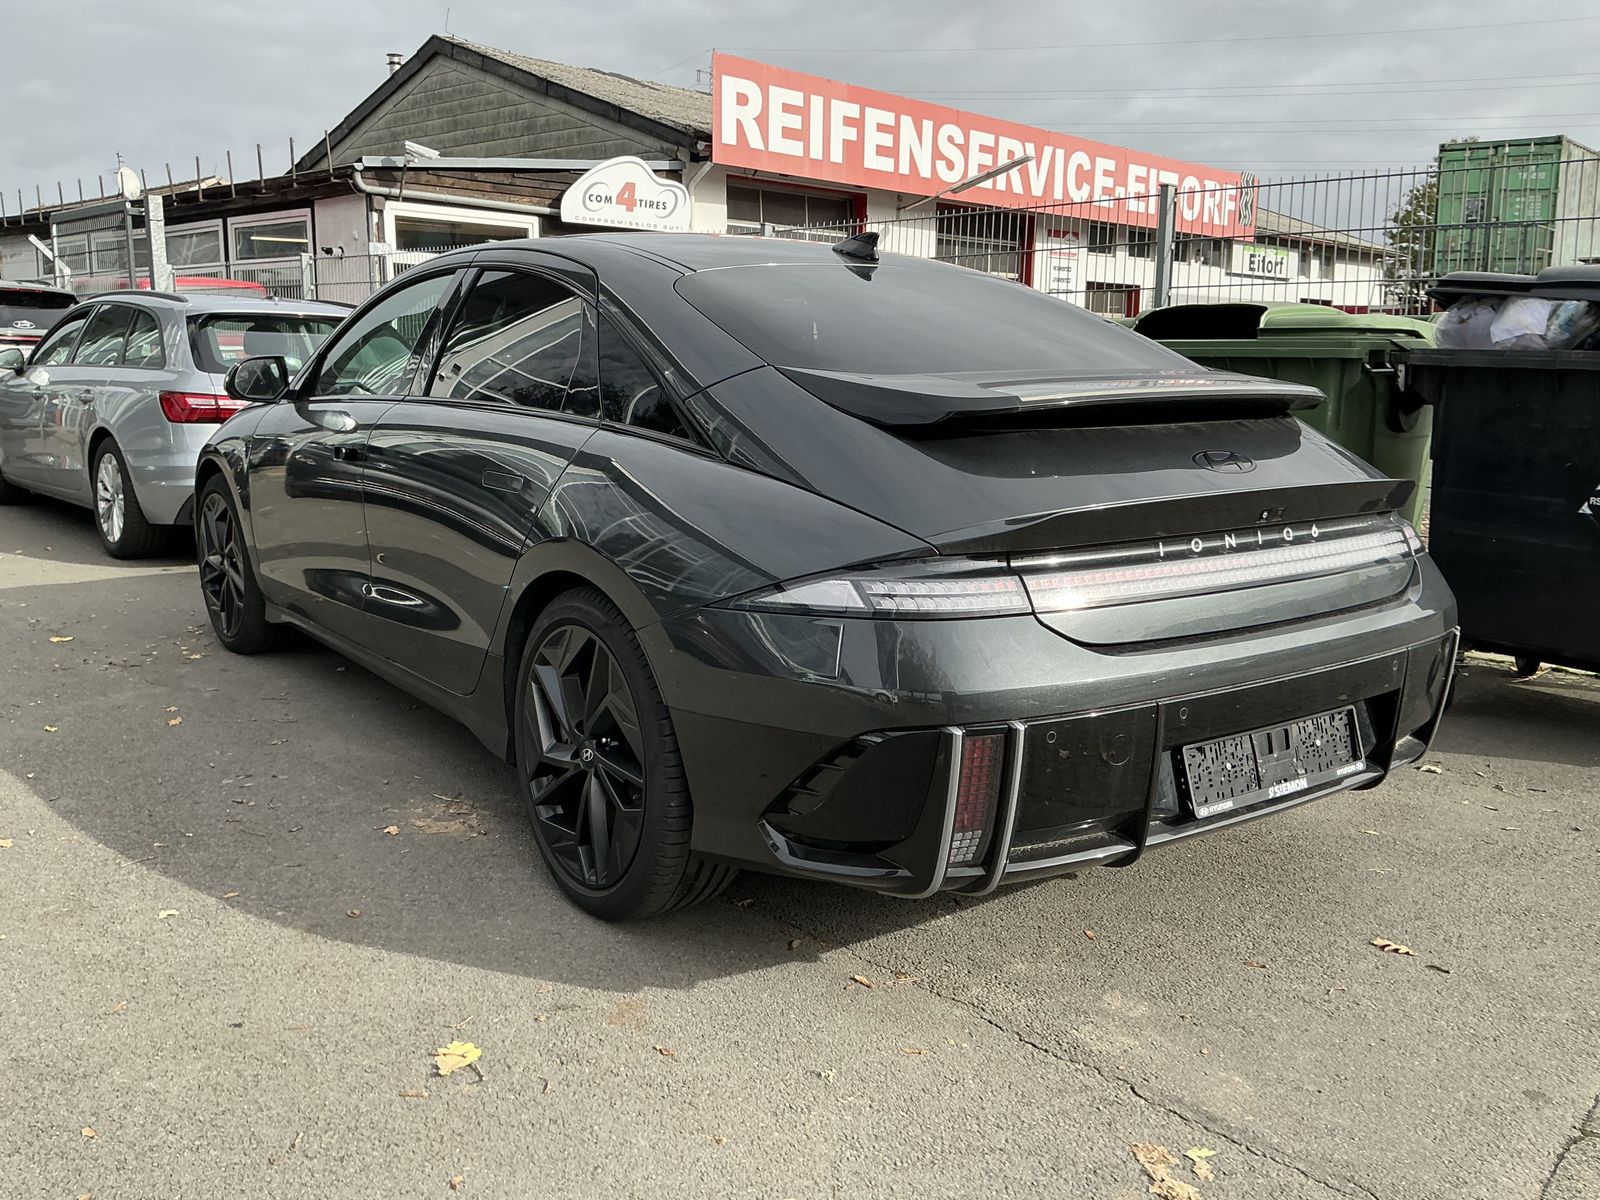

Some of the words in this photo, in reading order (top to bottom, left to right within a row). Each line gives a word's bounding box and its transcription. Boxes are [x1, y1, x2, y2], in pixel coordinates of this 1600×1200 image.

[588, 193, 613, 205] COM
[615, 181, 637, 213] 4
[638, 198, 668, 211] TIRES
[1248, 253, 1284, 275] Eitorf
